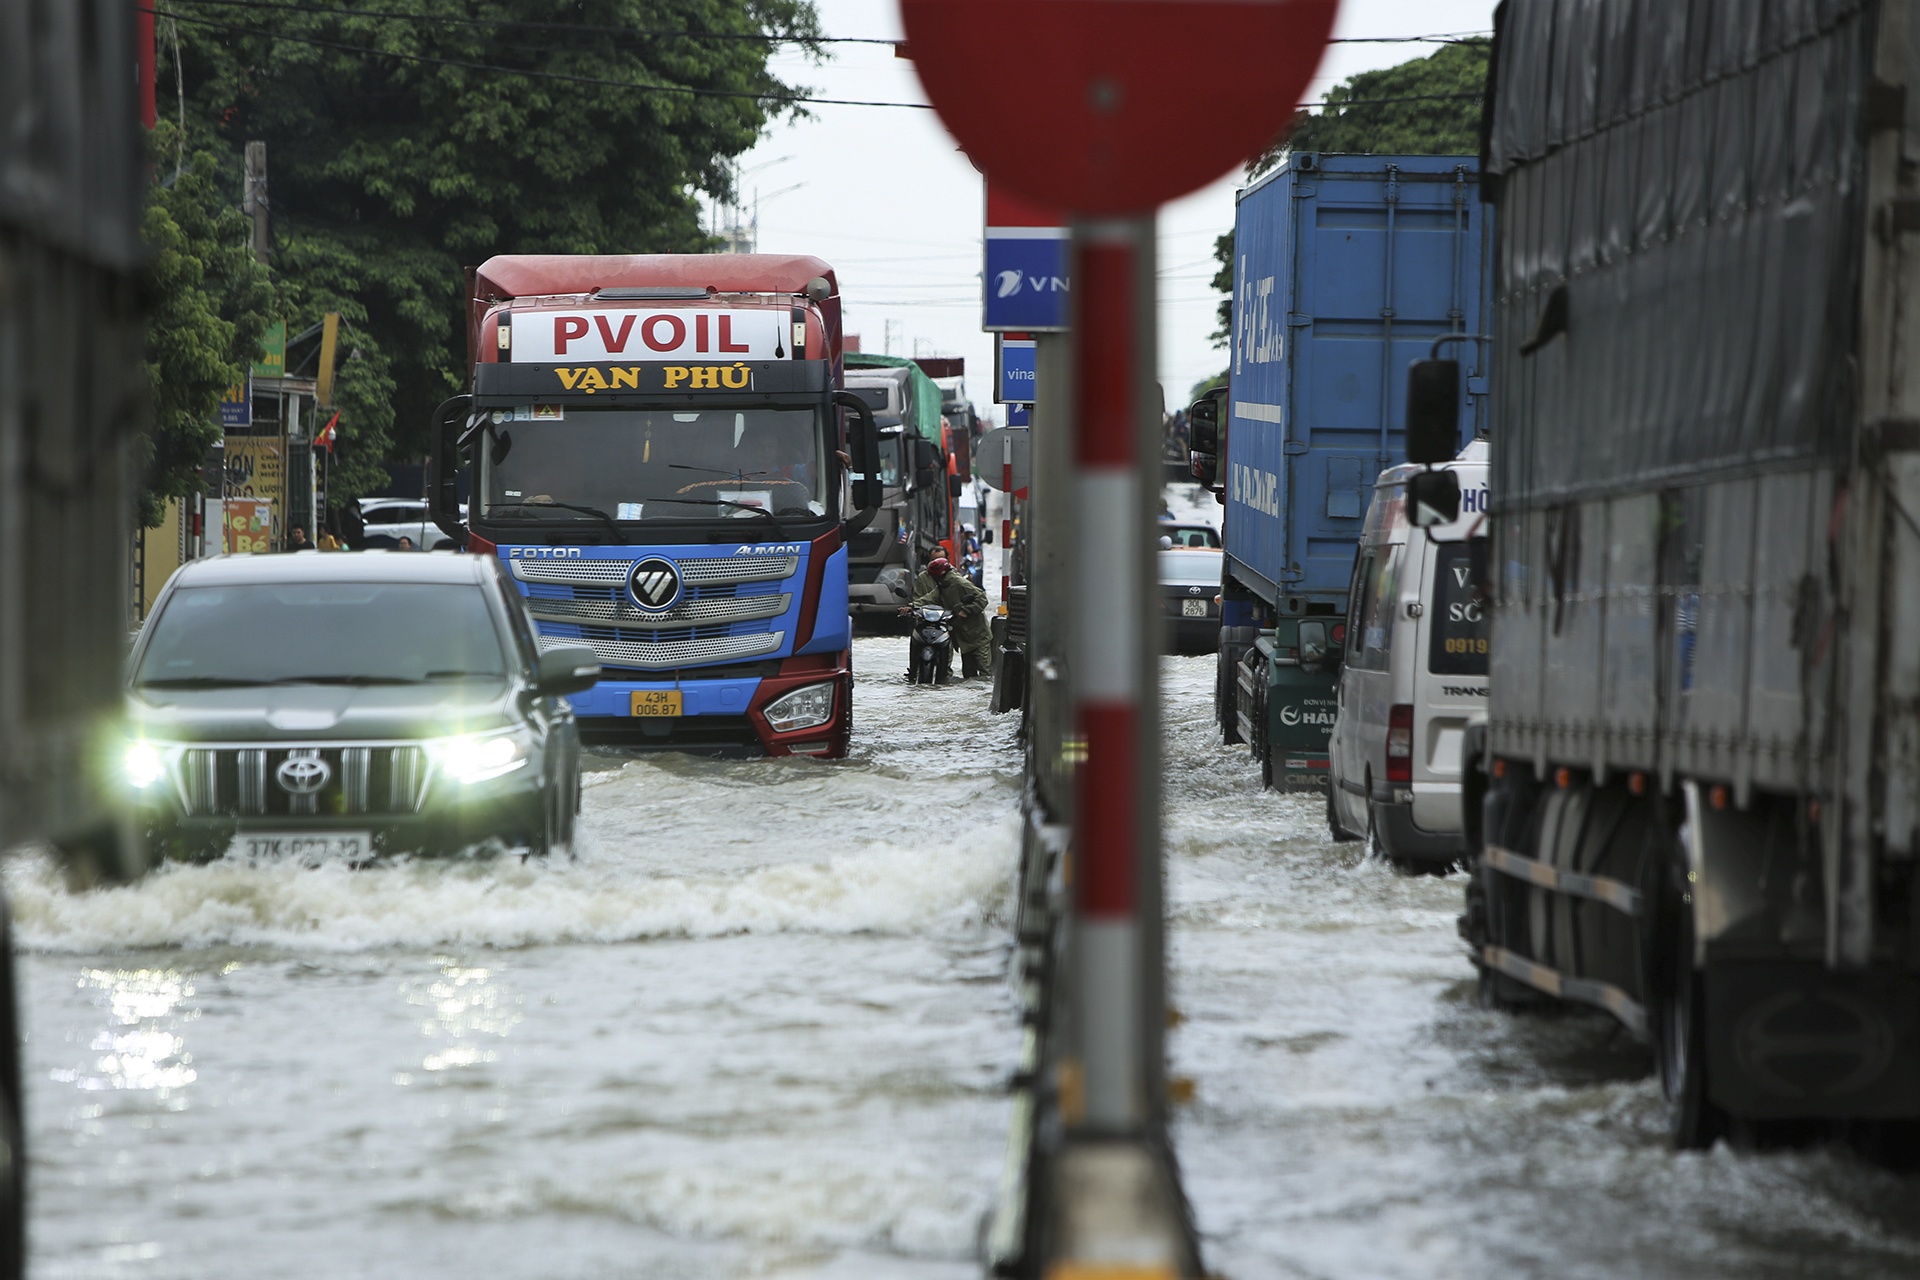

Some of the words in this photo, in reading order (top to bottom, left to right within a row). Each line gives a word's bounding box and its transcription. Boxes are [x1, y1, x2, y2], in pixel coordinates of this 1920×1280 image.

[554, 314, 750, 355] PVOIL
[554, 366, 641, 394] VẠN
[662, 361, 751, 389] PHÚ
[236, 535, 268, 553] Bé
[509, 547, 581, 559] FOTON
[733, 545, 800, 556] AUMAN
[645, 692, 668, 703] 43H
[636, 704, 677, 715] 006.87
